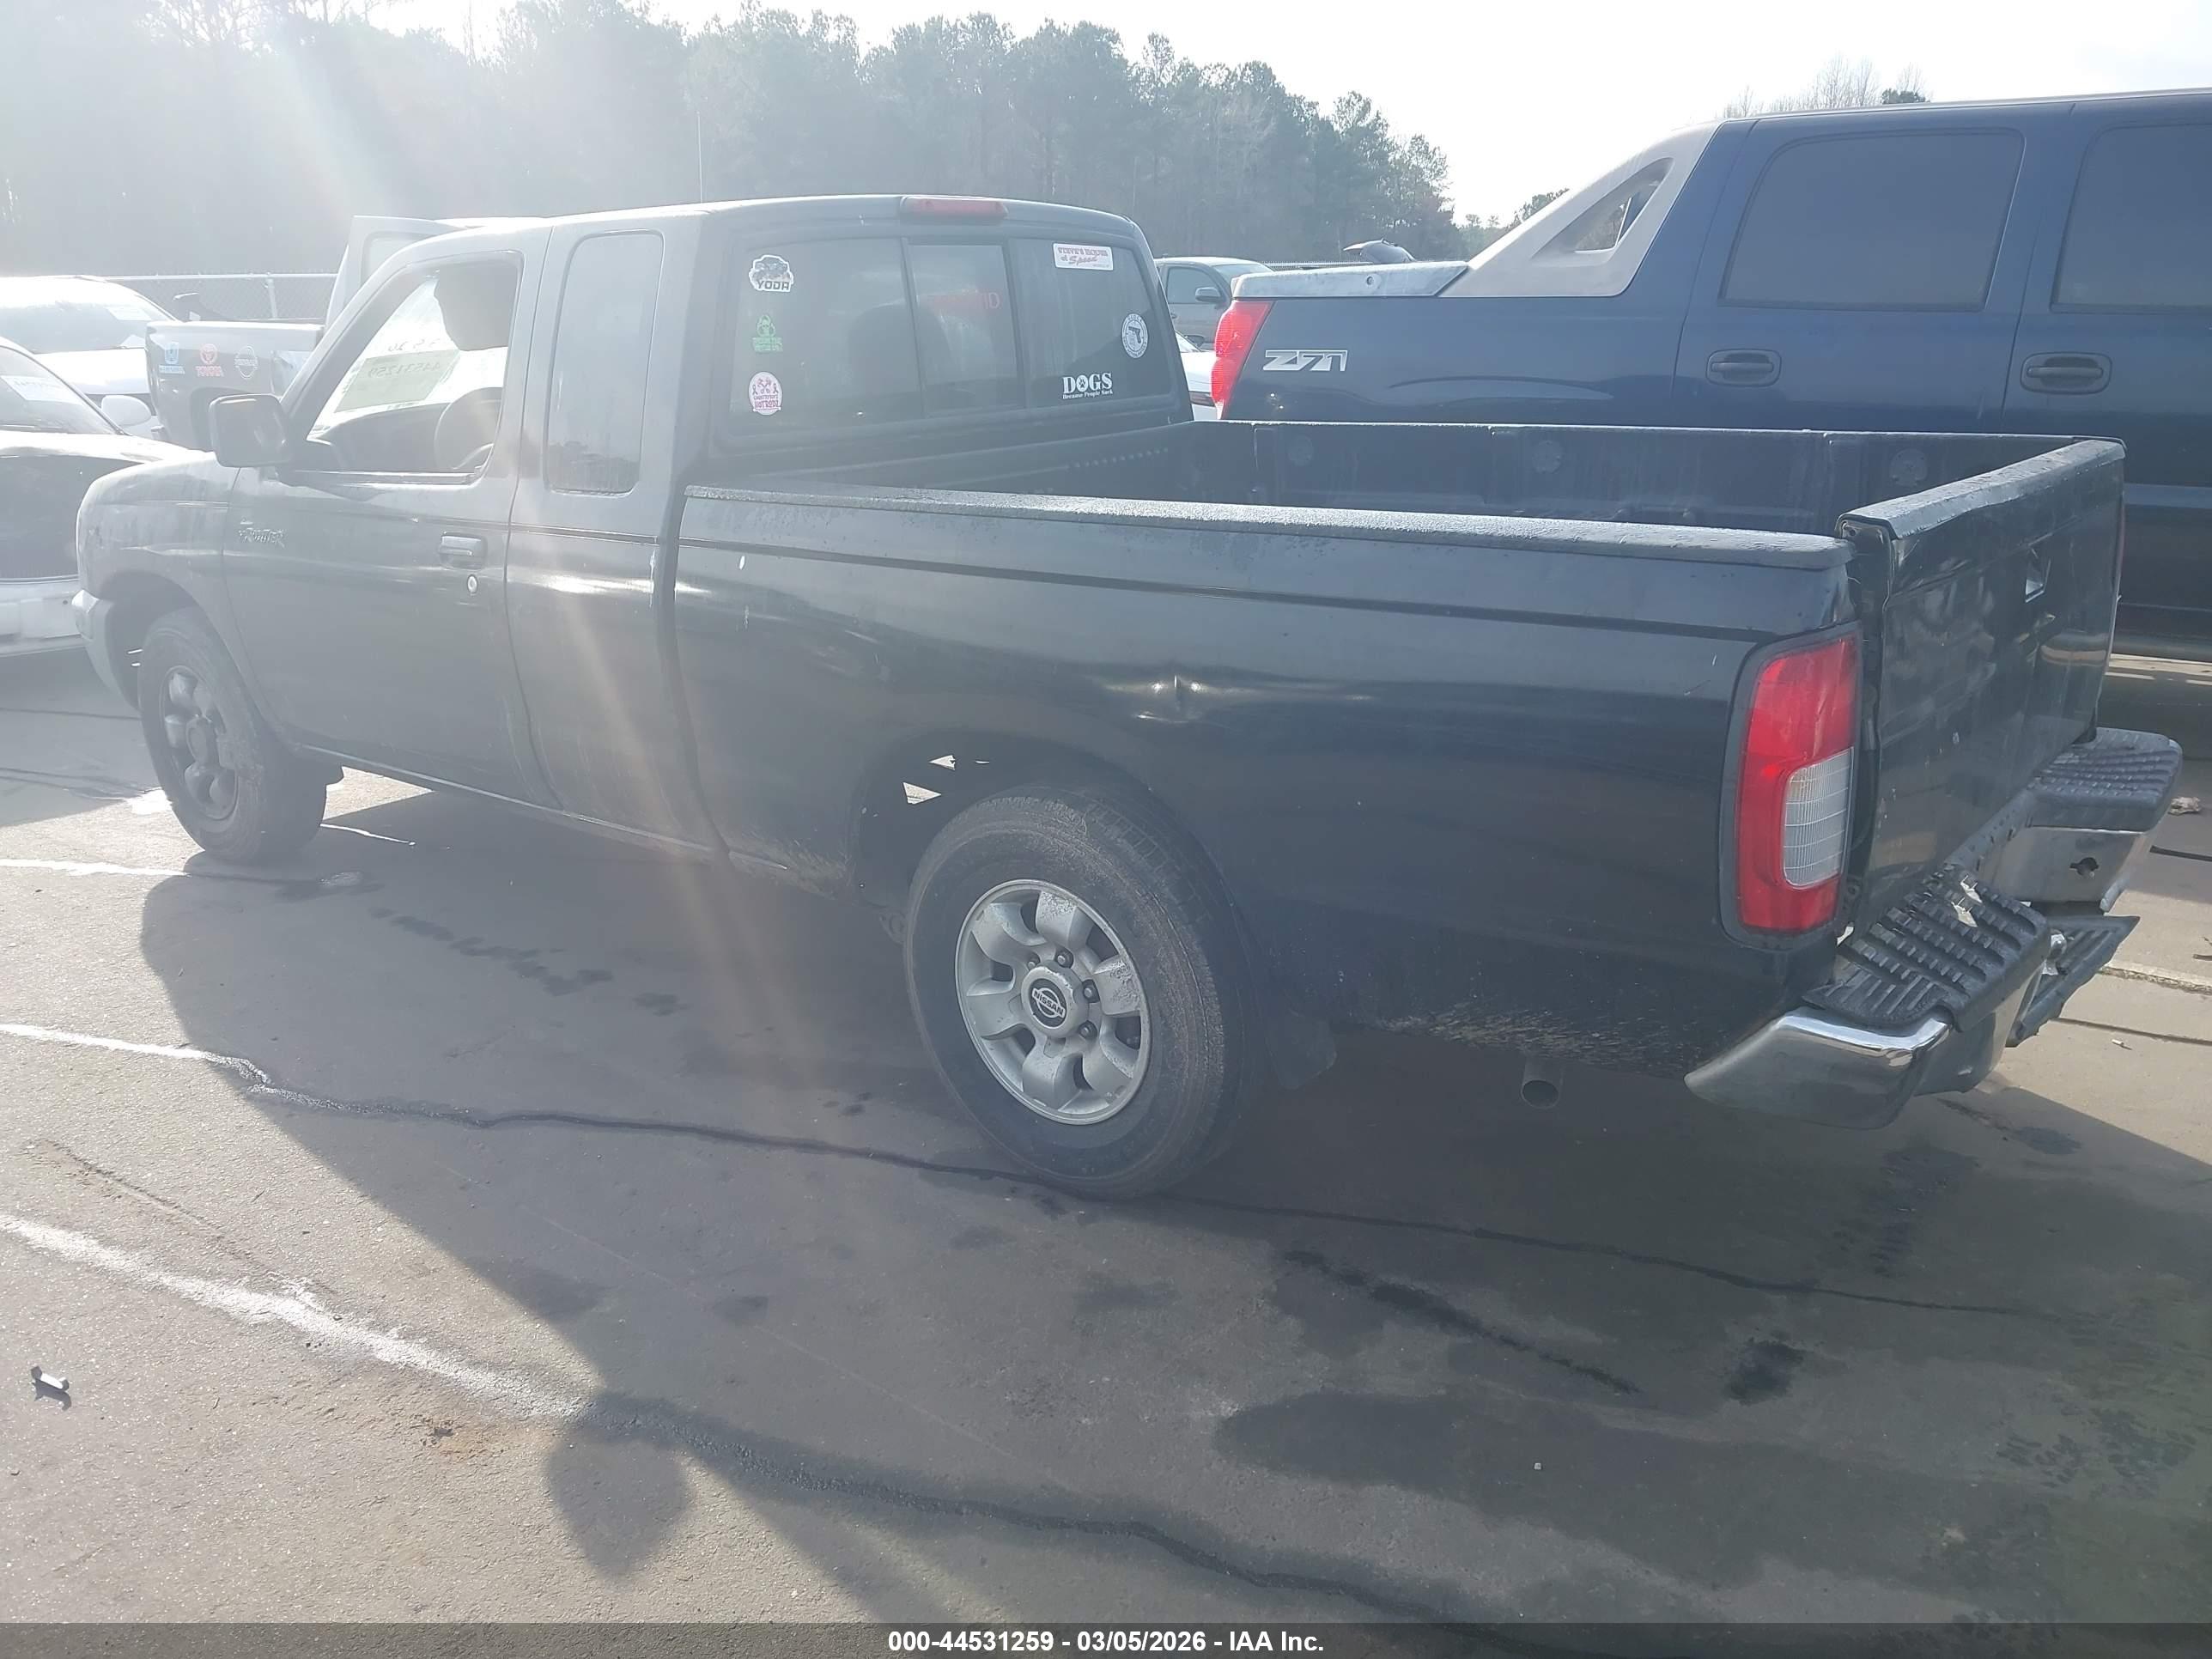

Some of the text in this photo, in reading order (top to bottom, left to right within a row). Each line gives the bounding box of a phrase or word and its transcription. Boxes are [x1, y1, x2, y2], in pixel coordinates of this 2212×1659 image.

[1262, 349, 1348, 372] Z71
[1063, 372, 1113, 394] DOGS
[1033, 989, 1065, 1017] NISSAN
